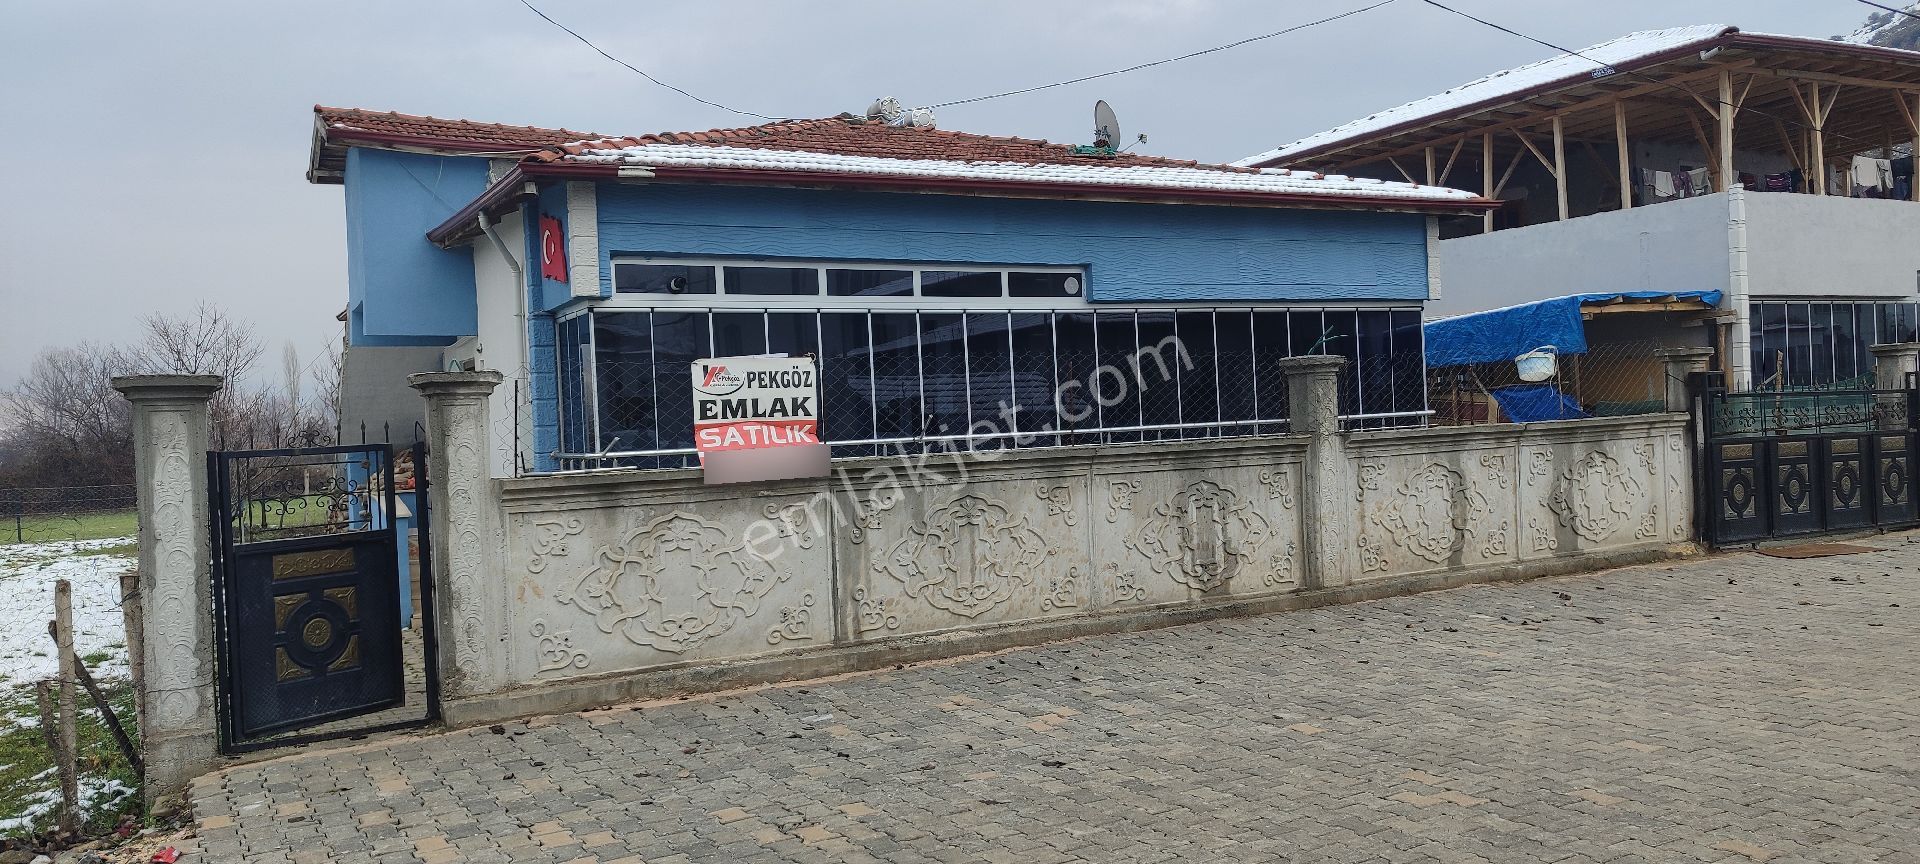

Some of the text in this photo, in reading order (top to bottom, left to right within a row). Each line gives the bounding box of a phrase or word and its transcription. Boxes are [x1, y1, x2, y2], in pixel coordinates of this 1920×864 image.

[746, 366, 813, 389] PEKGÖZ
[698, 396, 813, 421] EMLAK
[699, 424, 813, 448] SATILIK
